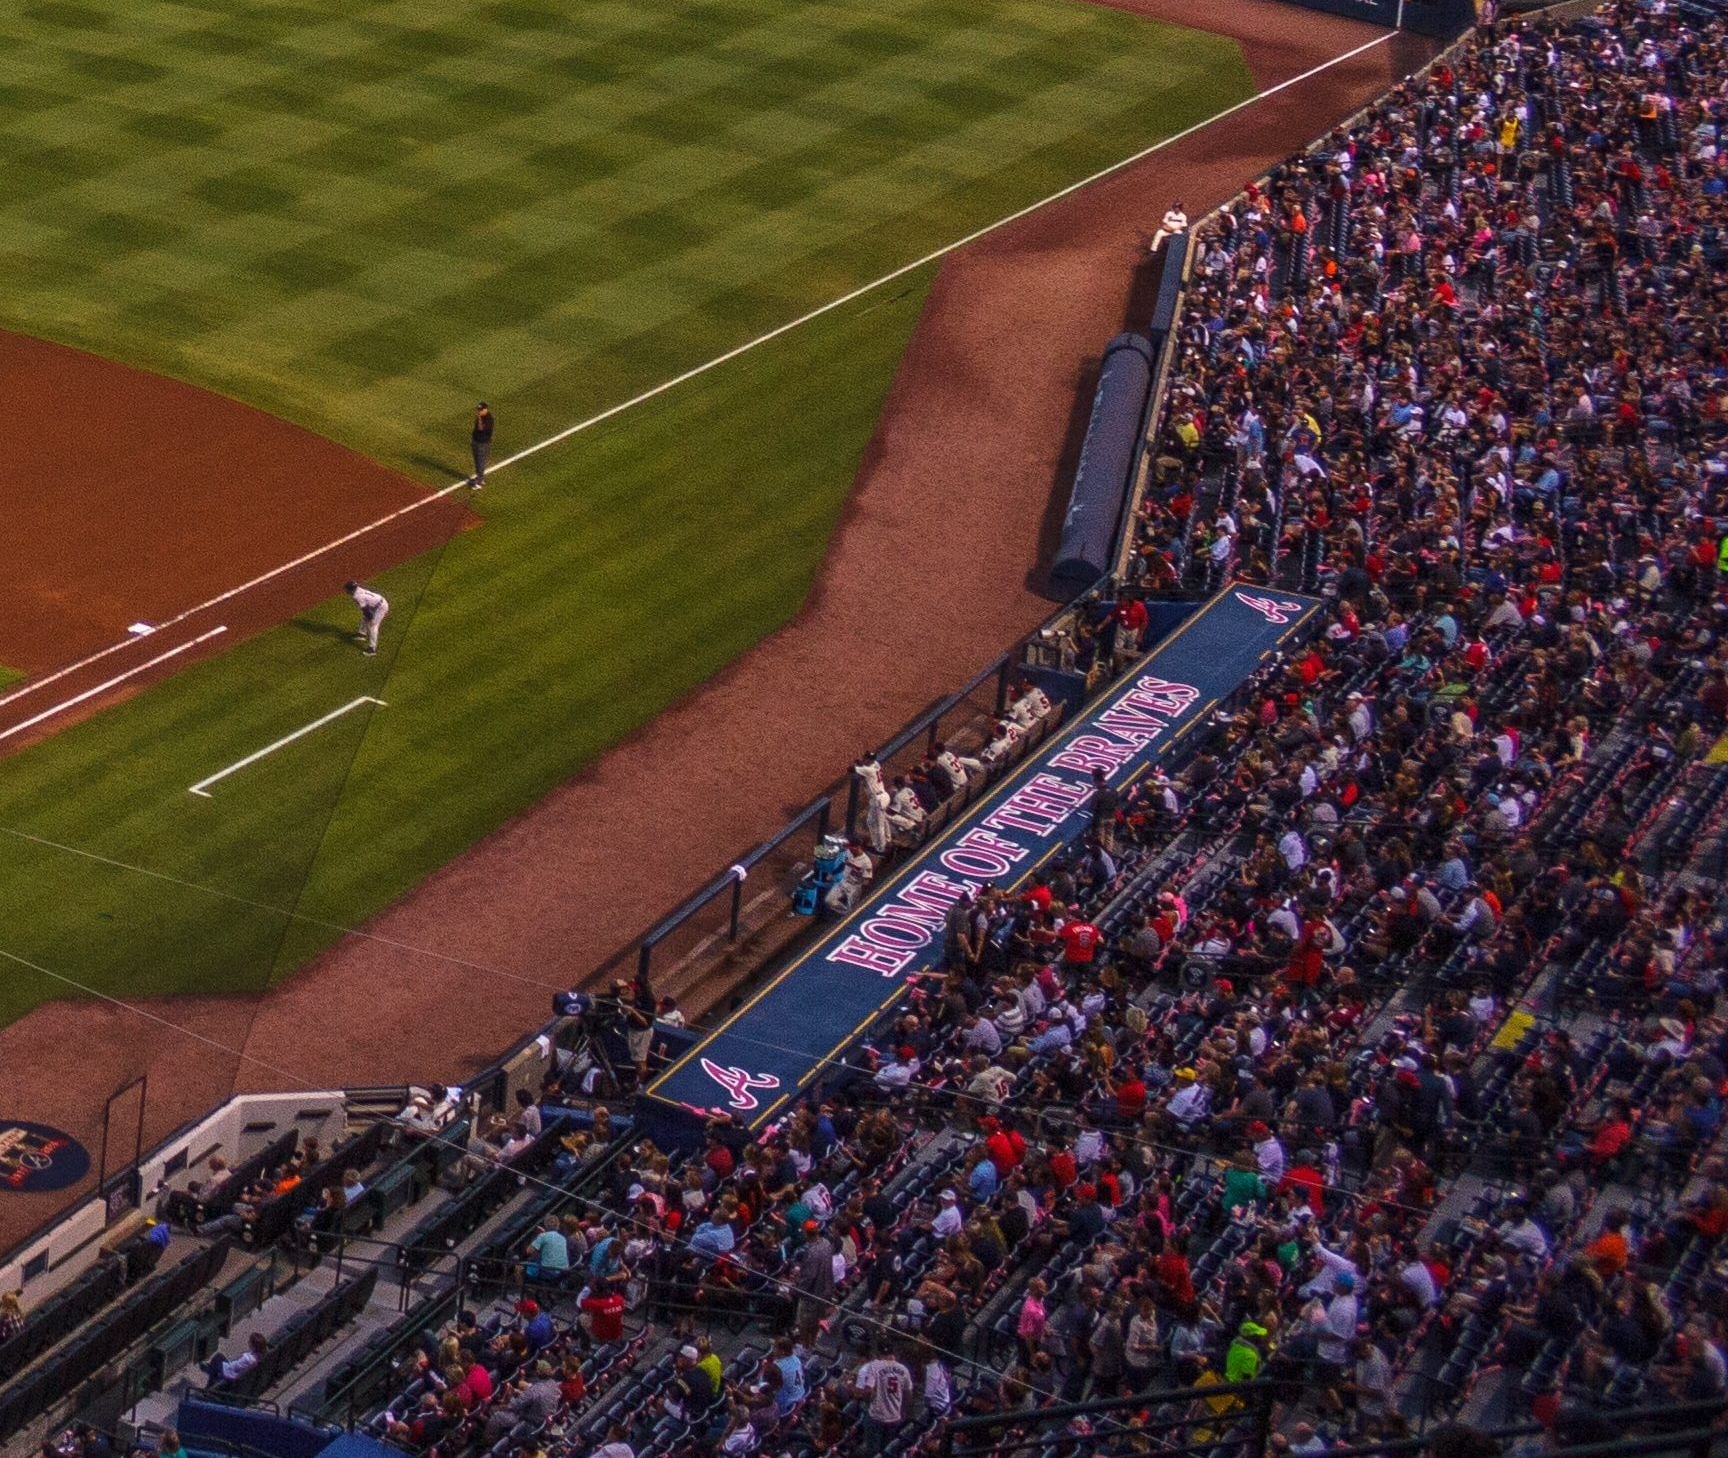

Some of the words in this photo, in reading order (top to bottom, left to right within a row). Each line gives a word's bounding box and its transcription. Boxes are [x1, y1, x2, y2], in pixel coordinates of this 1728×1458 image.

[1048, 675, 1201, 782] BRAVES
[982, 771, 1097, 842] THE
[940, 828, 1029, 887] OF
[826, 869, 967, 979] HOME
